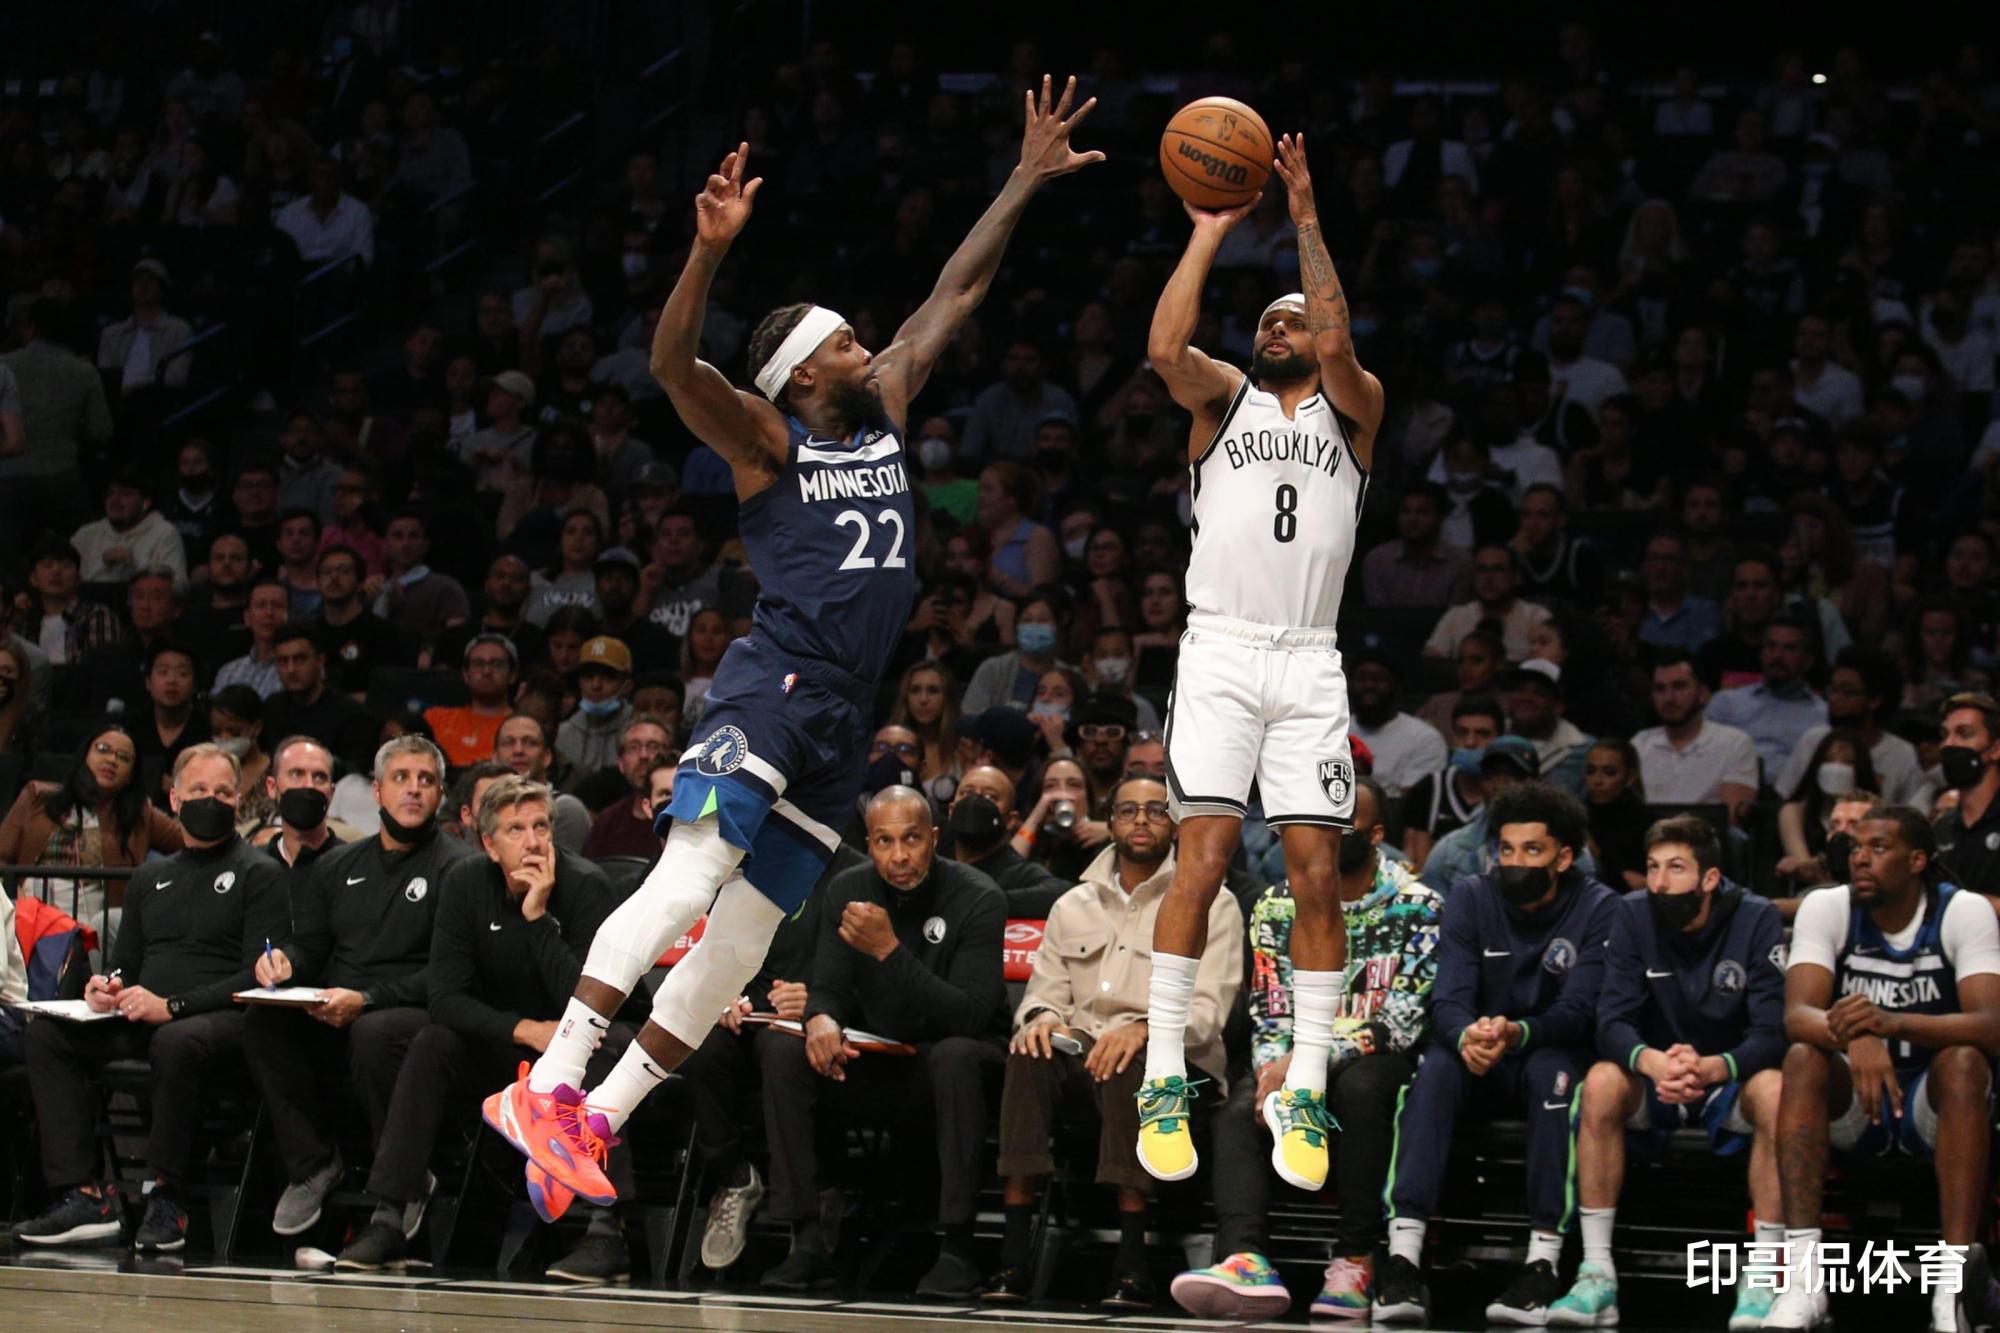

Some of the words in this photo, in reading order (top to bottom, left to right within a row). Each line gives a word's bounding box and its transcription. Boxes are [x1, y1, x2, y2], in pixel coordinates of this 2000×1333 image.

[1178, 140, 1248, 185] Wilson
[1224, 430, 1341, 478] BROOKLYN
[798, 462, 909, 503] MINNESOTA
[1274, 484, 1297, 543] 8
[834, 508, 906, 571] 22
[1321, 762, 1351, 783] NETS
